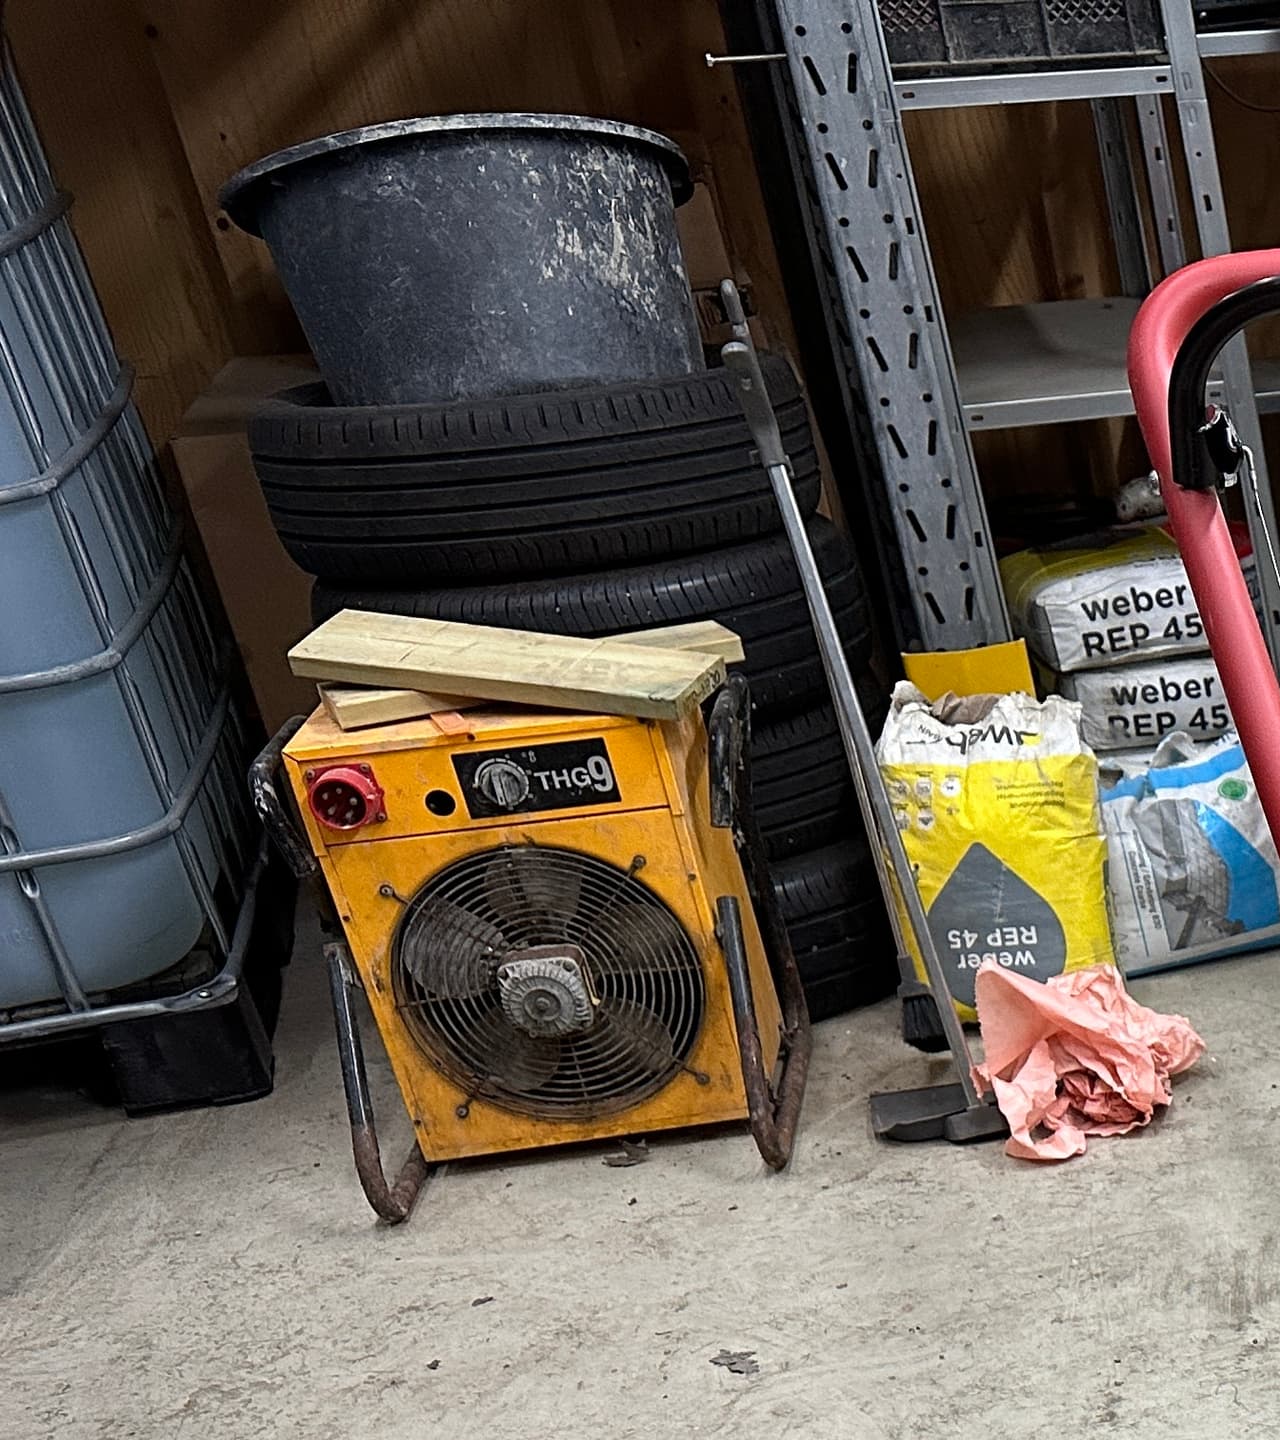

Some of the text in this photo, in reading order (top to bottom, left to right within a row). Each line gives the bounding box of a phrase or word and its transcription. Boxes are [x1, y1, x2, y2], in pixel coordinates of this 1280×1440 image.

[1081, 584, 1187, 622] weber
[1082, 613, 1203, 658] REP 45
[1111, 676, 1215, 706] weber
[1108, 704, 1229, 739] REP 45
[947, 926, 1038, 949] REP 45
